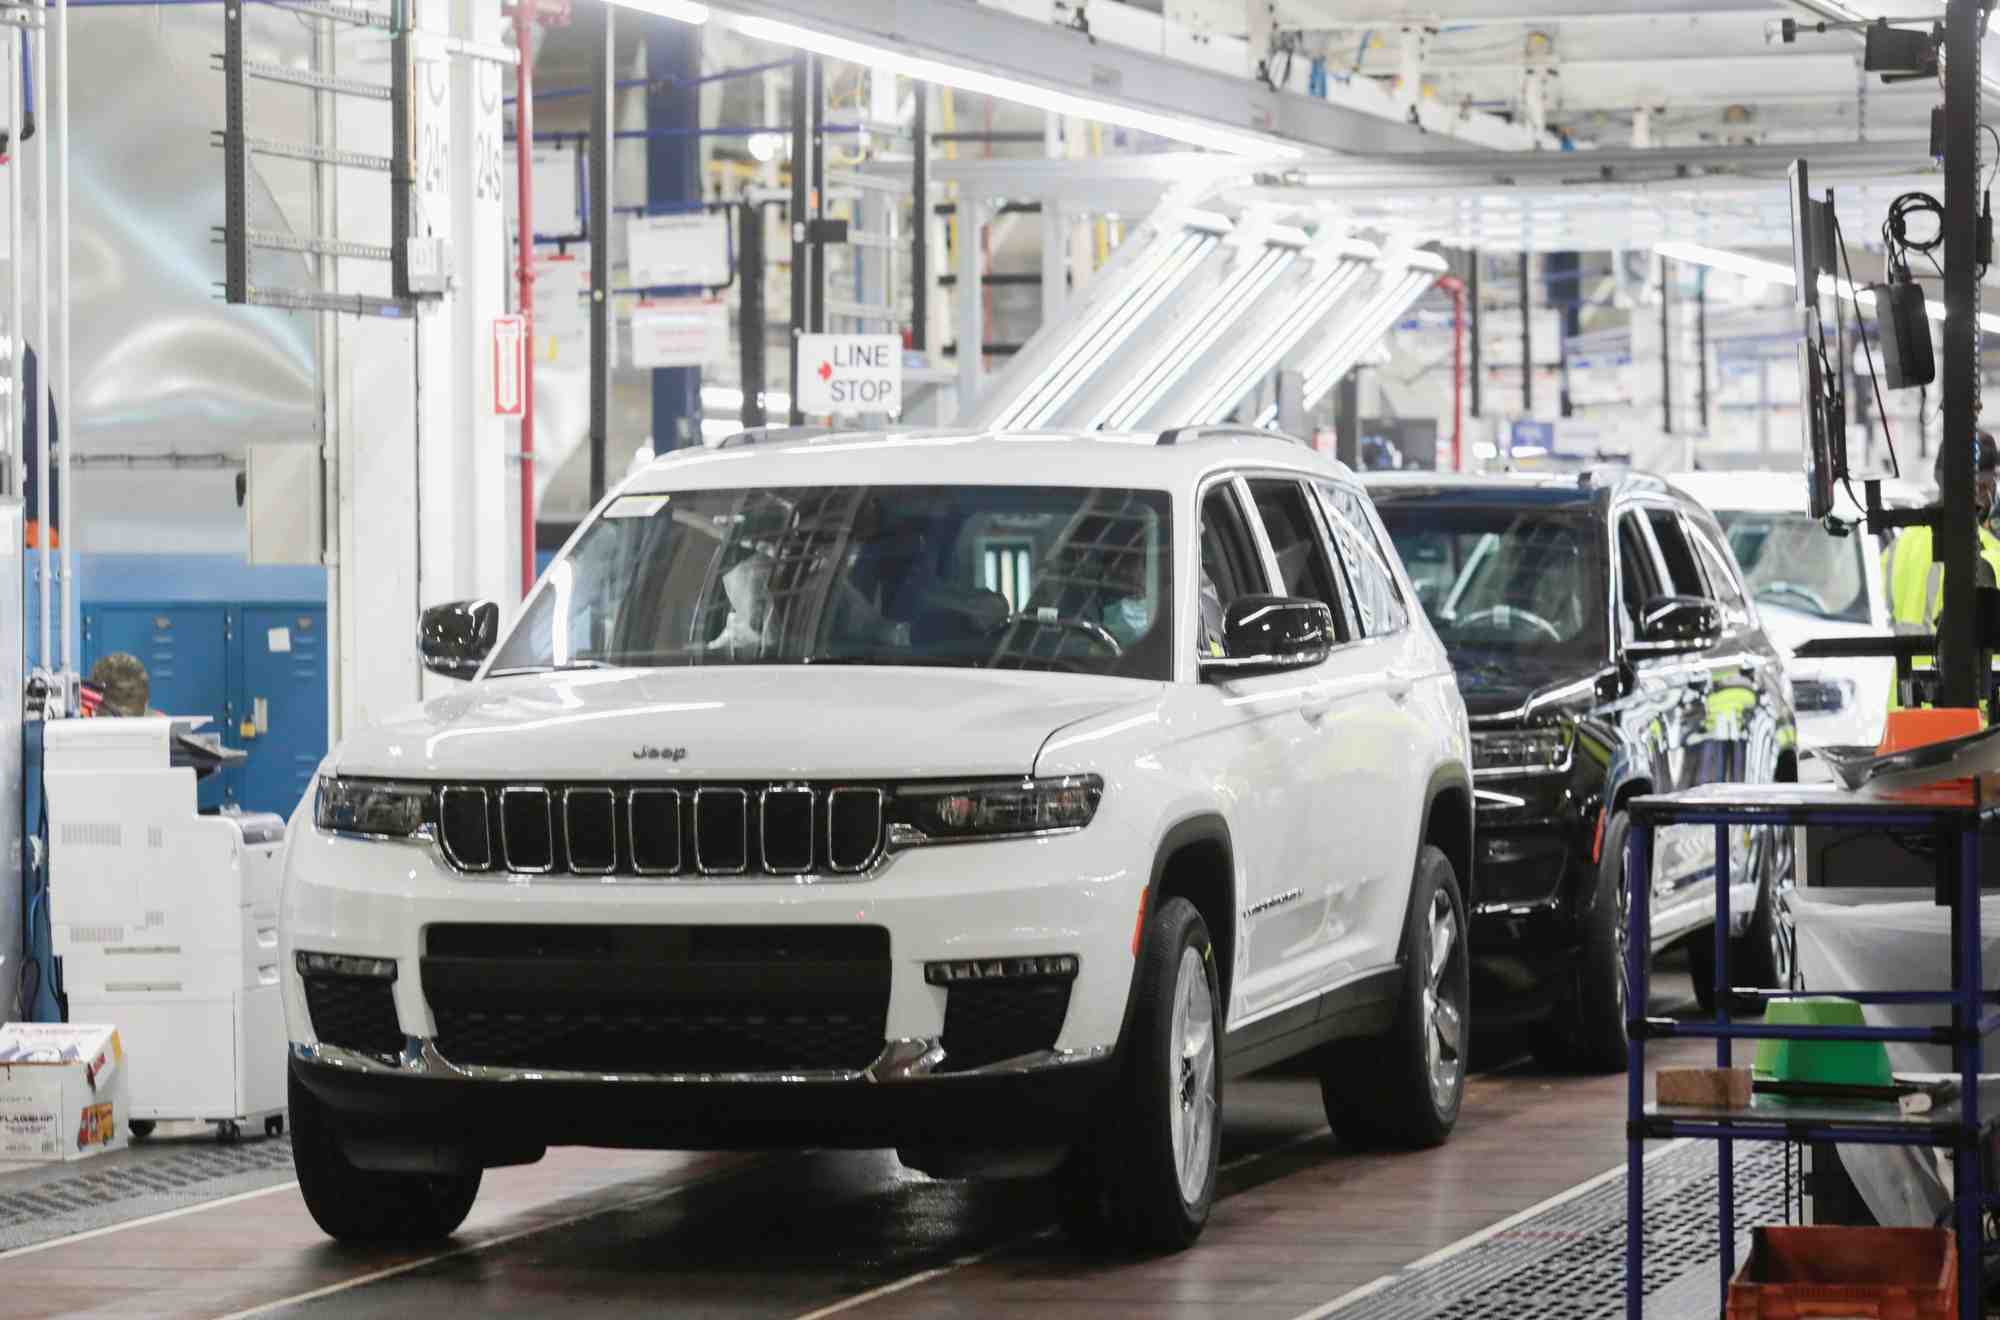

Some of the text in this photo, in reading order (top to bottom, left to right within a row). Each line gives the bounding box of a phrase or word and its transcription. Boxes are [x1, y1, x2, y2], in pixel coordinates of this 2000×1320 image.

[833, 344, 888, 367] LINE
[831, 379, 892, 402] STOP
[632, 744, 687, 763] Jeep
